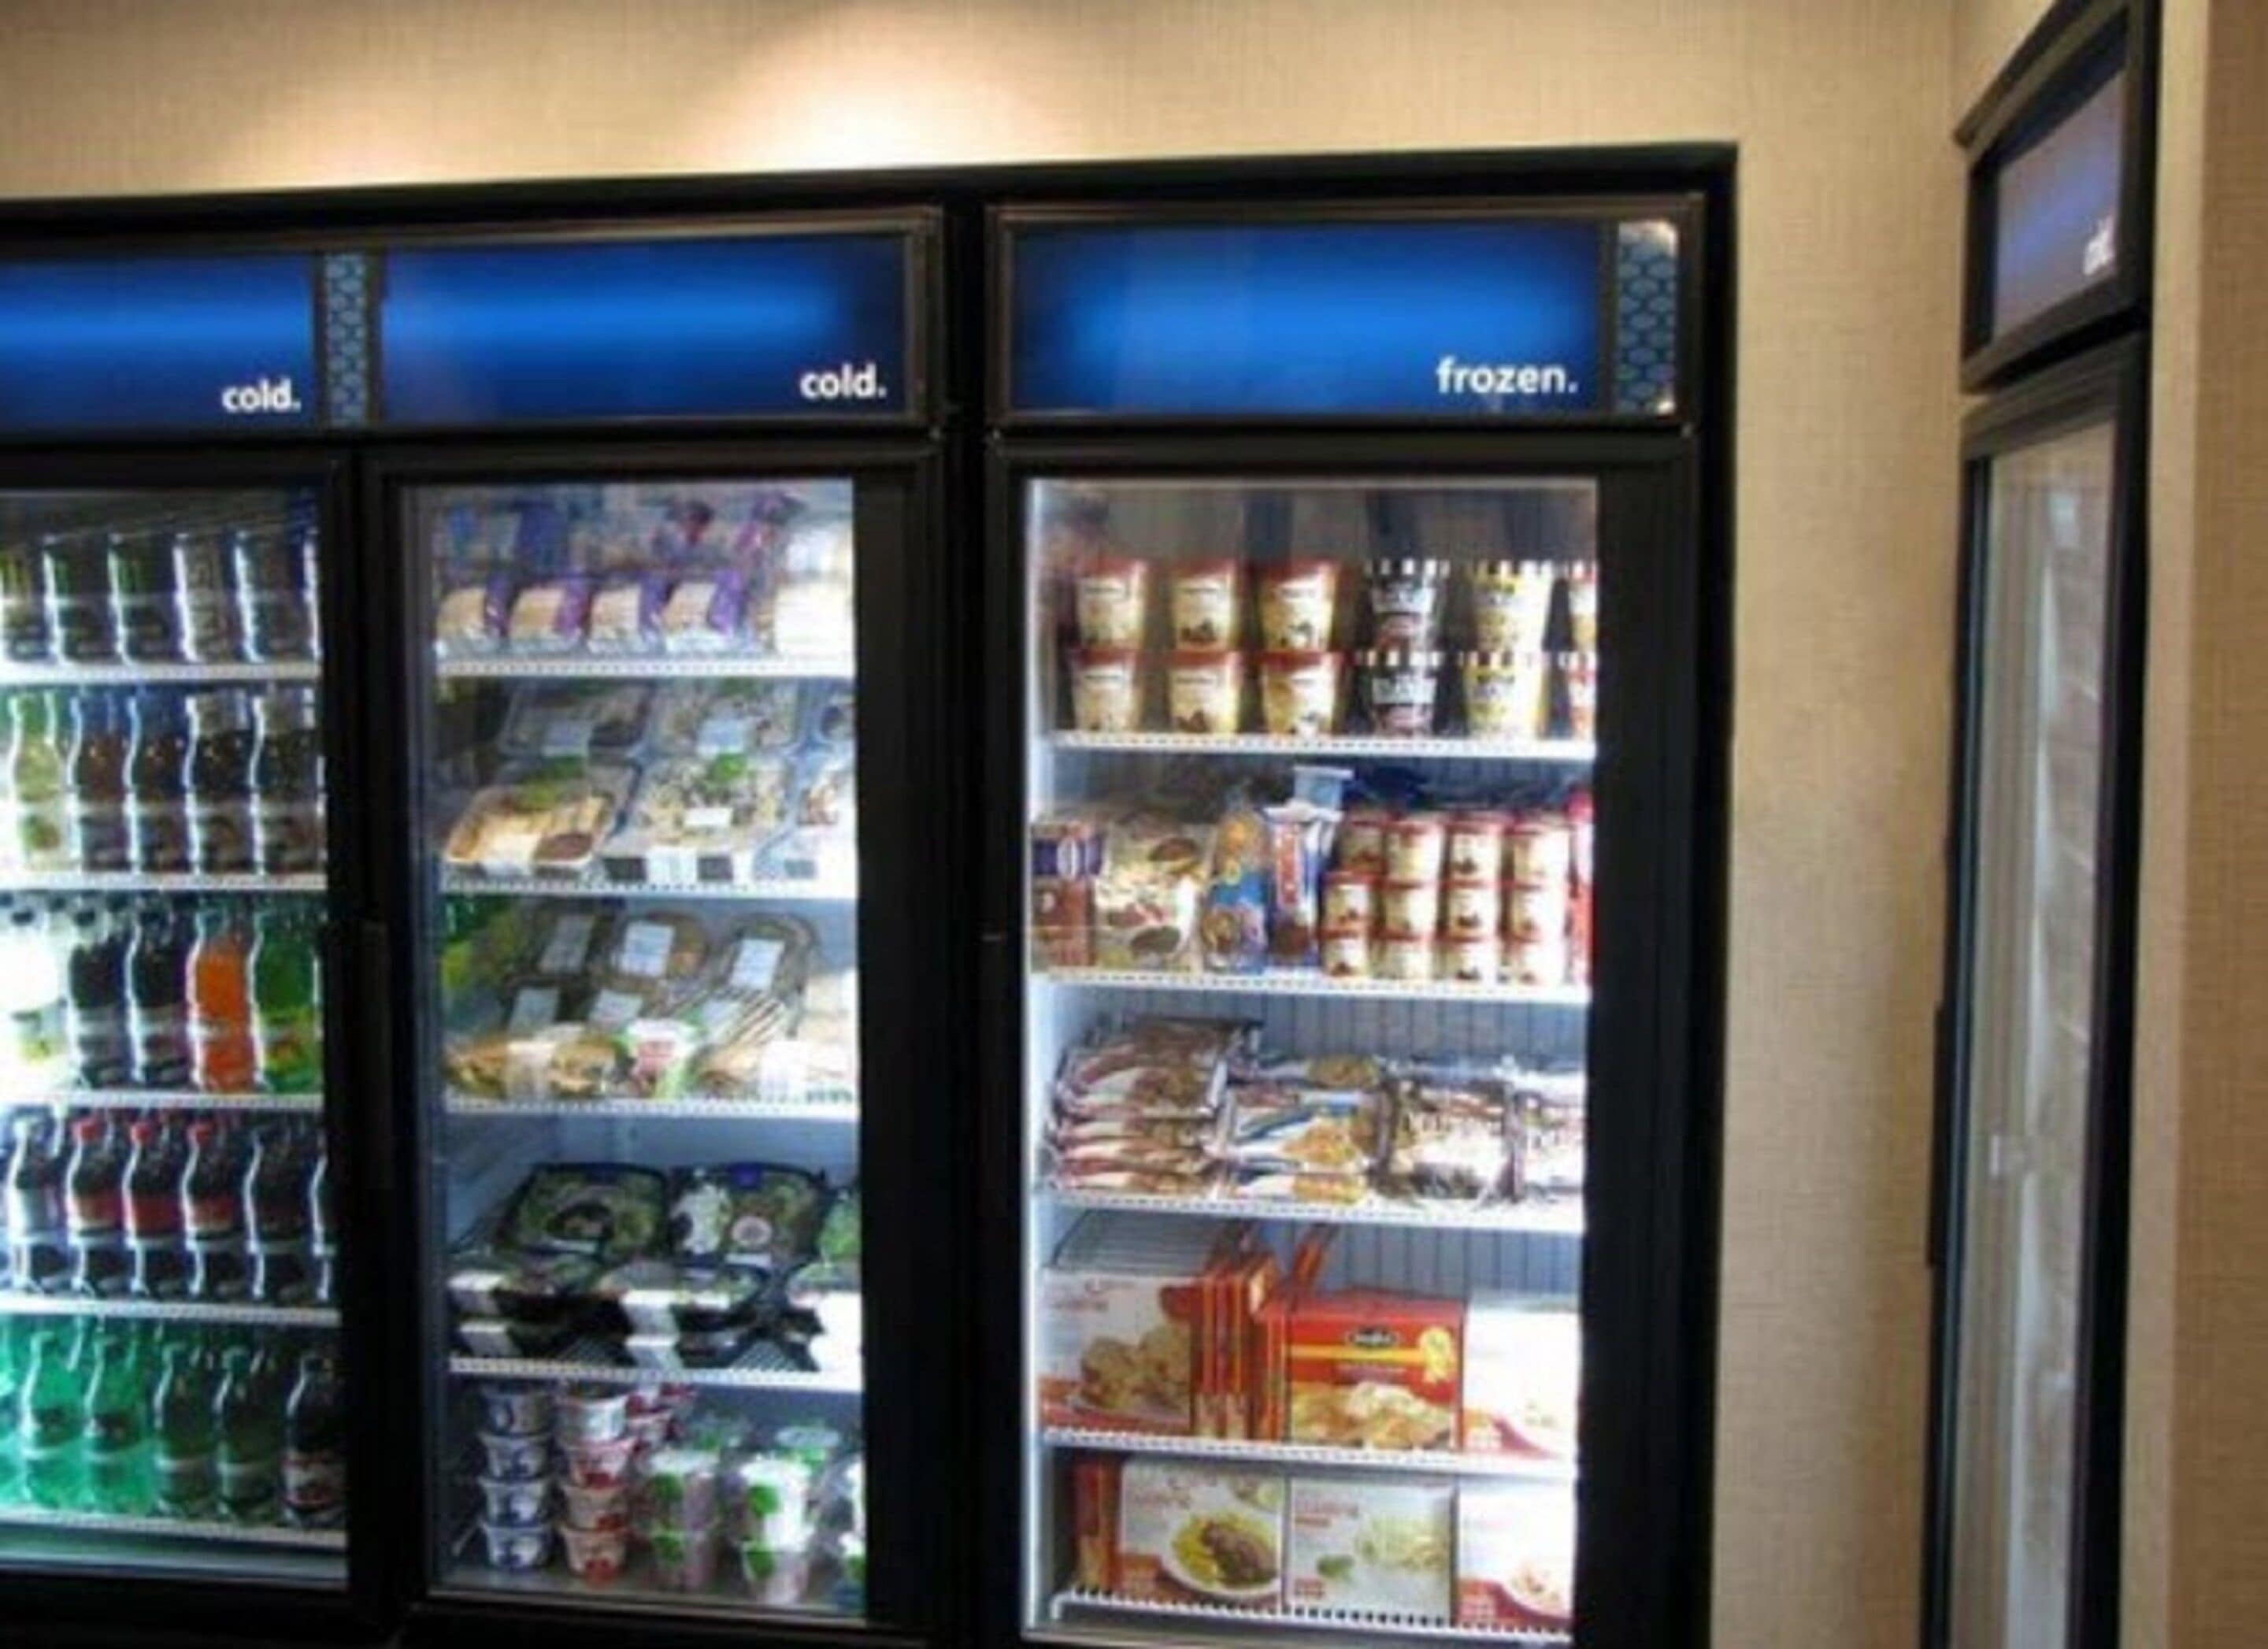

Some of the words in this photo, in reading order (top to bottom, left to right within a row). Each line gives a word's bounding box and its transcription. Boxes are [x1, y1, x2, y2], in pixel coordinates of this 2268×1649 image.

[799, 362, 888, 399] cold.
[1435, 355, 1579, 394] frozen.
[221, 376, 302, 413] cold.
